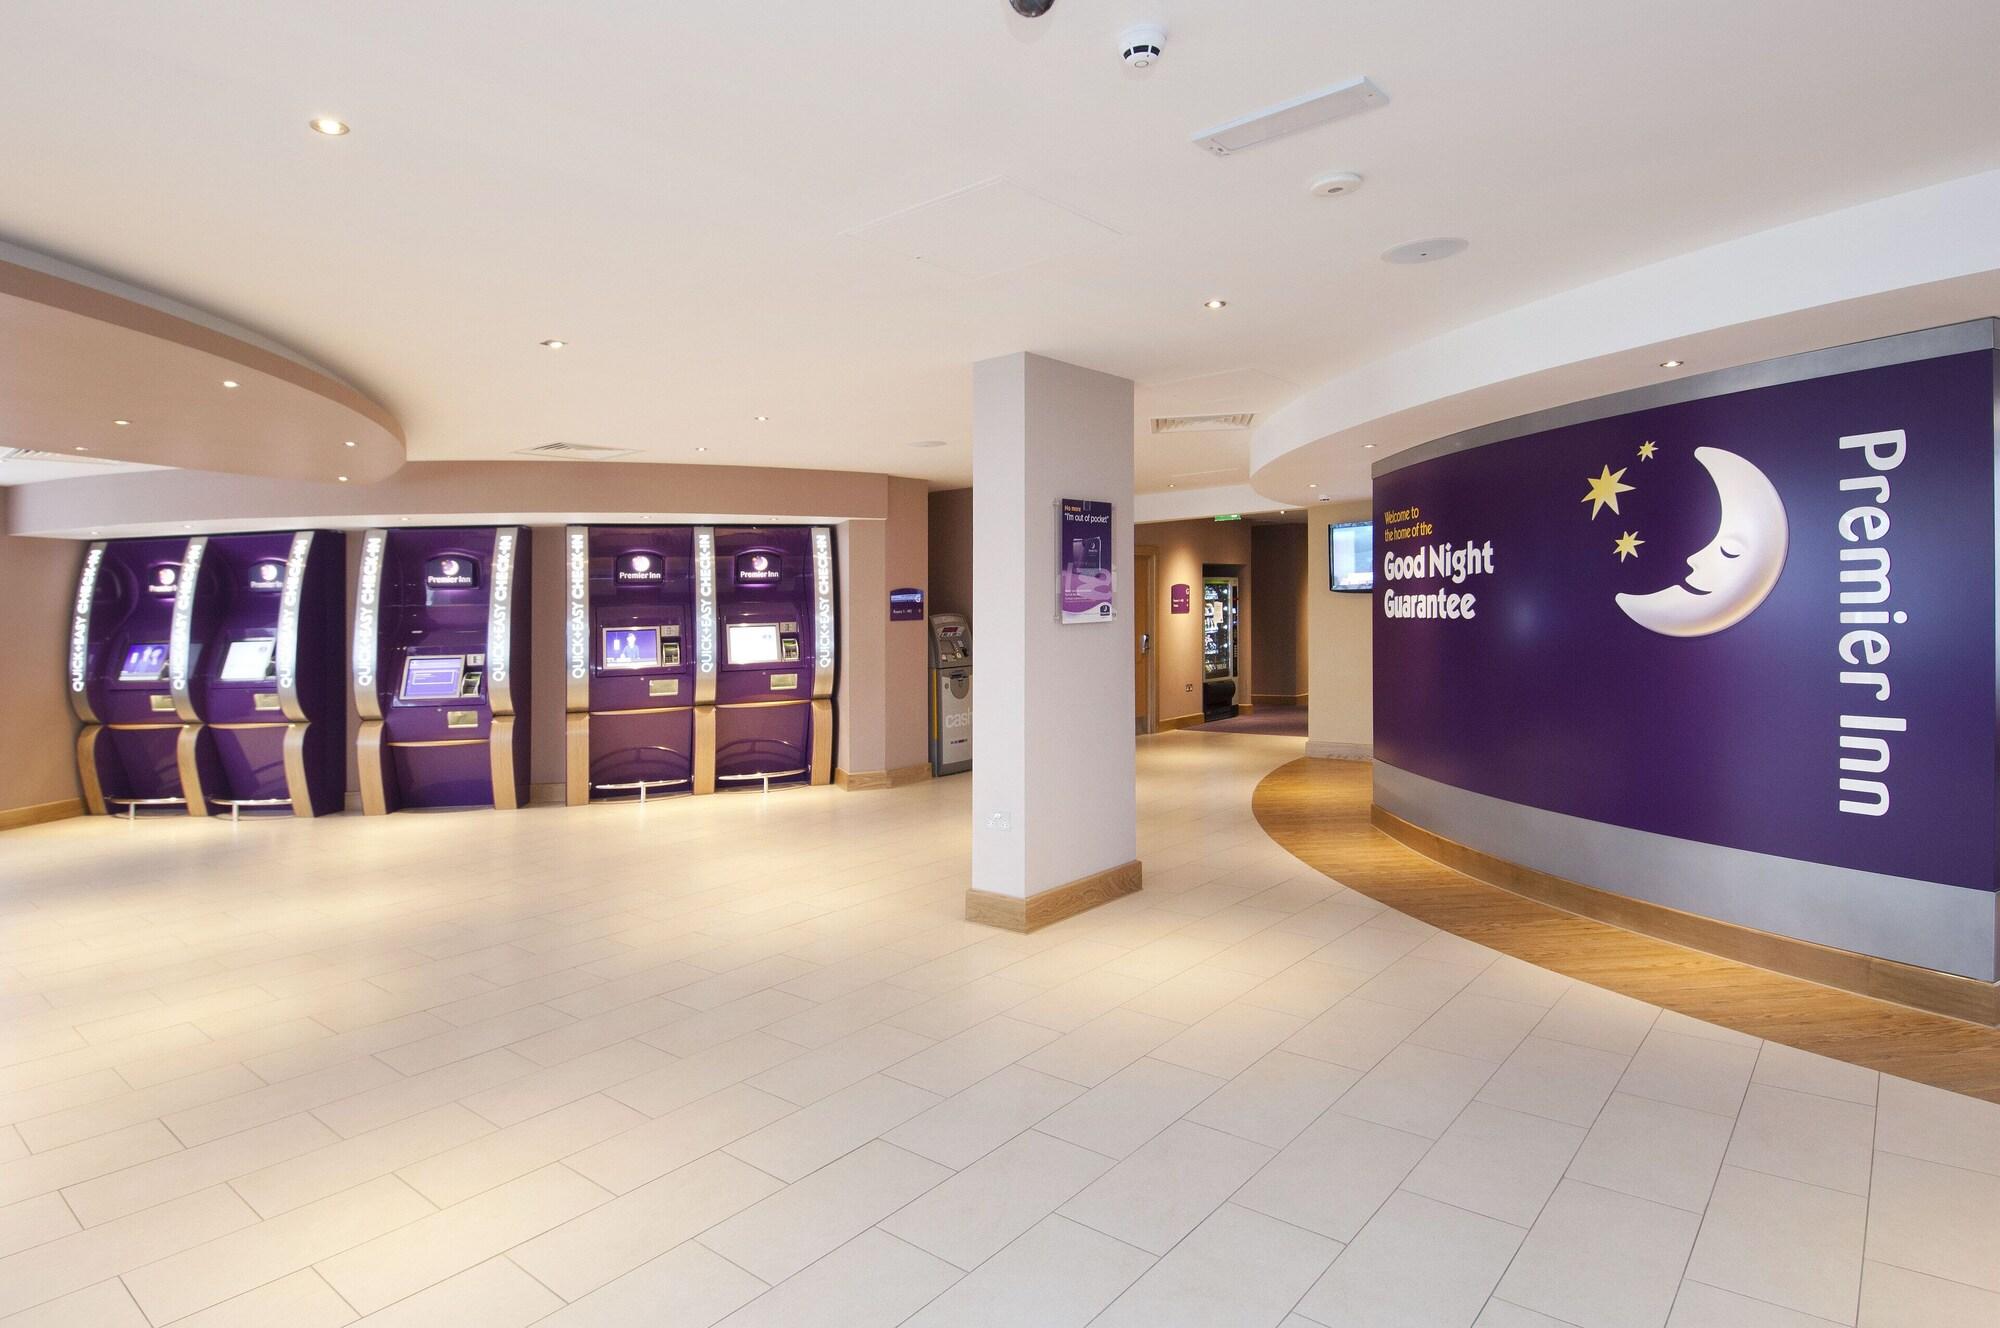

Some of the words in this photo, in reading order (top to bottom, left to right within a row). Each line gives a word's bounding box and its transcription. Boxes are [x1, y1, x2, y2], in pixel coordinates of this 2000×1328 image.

[1074, 514, 1084, 522] out
[1084, 513, 1090, 522] of
[1384, 508, 1410, 525] Welcome
[1411, 506, 1420, 519] to
[1384, 527, 1394, 542] the
[1394, 525, 1411, 540] home
[1411, 522, 1420, 537] of
[1420, 521, 1433, 536] the
[1384, 545, 1426, 581] Good
[1429, 540, 1495, 584] Night
[1838, 428, 1908, 702] Premier
[428, 575, 458, 583] Premier
[619, 571, 648, 580] Premier
[649, 570, 661, 579] Inn
[740, 570, 767, 579] Premier
[768, 570, 779, 578] Inn
[1384, 588, 1477, 620] Guarantee
[1838, 714, 1908, 818] Inn
